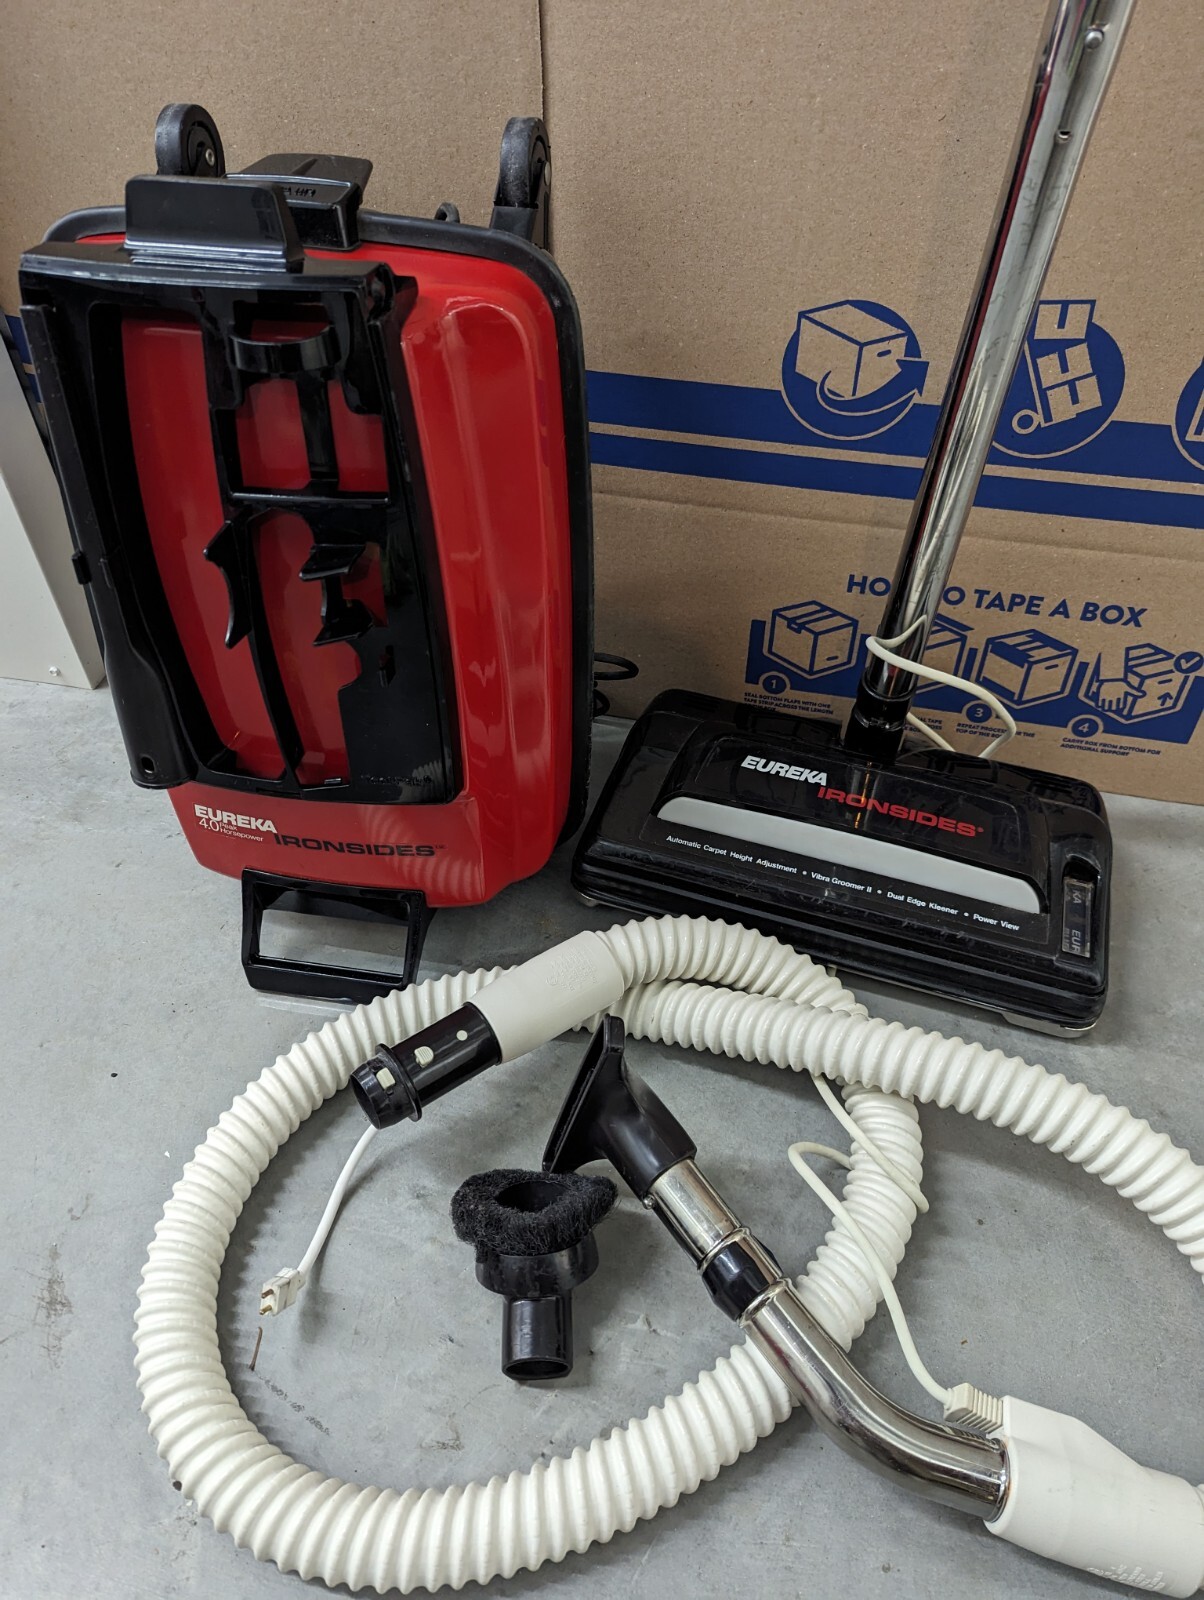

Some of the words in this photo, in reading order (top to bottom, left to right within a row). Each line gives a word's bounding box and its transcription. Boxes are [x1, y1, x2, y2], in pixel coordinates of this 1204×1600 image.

[846, 574, 891, 597] HO
[943, 586, 965, 606] O
[973, 588, 1045, 616] TAPE
[1048, 598, 1070, 619] A
[1079, 601, 1147, 628] BOX
[771, 679, 777, 689] 1
[759, 693, 783, 702] BOTTOM
[783, 697, 800, 705] FLAPS
[759, 699, 774, 707] STRIP
[775, 702, 798, 710] ACROSS
[810, 706, 834, 715] LENGTH
[974, 708, 984, 718] 3
[957, 722, 980, 730] REPEAT
[1078, 722, 1090, 733] 4
[1060, 743, 1099, 753] ADDITIONAL
[1100, 748, 1130, 757] SUPPORT
[1062, 737, 1084, 745] CARRY
[1099, 742, 1118, 750] FROM
[1119, 745, 1146, 754] BOTTOM
[740, 754, 828, 787] EUREKA
[194, 803, 278, 834] EUREKA
[199, 817, 220, 832] 4.0
[220, 827, 264, 842] Horsepower
[274, 833, 435, 857] IRONSIDES
[666, 835, 701, 849] Automatic
[703, 844, 727, 856] Carpet
[729, 851, 753, 863] Height
[756, 857, 798, 874] Adjustment
[811, 871, 830, 883] Vibra
[831, 877, 865, 892] Groomer
[887, 891, 905, 901] Dual
[906, 896, 926, 908] Edge
[928, 902, 959, 915] Kleener
[972, 913, 998, 926] Power
[1000, 920, 1020, 931] View
